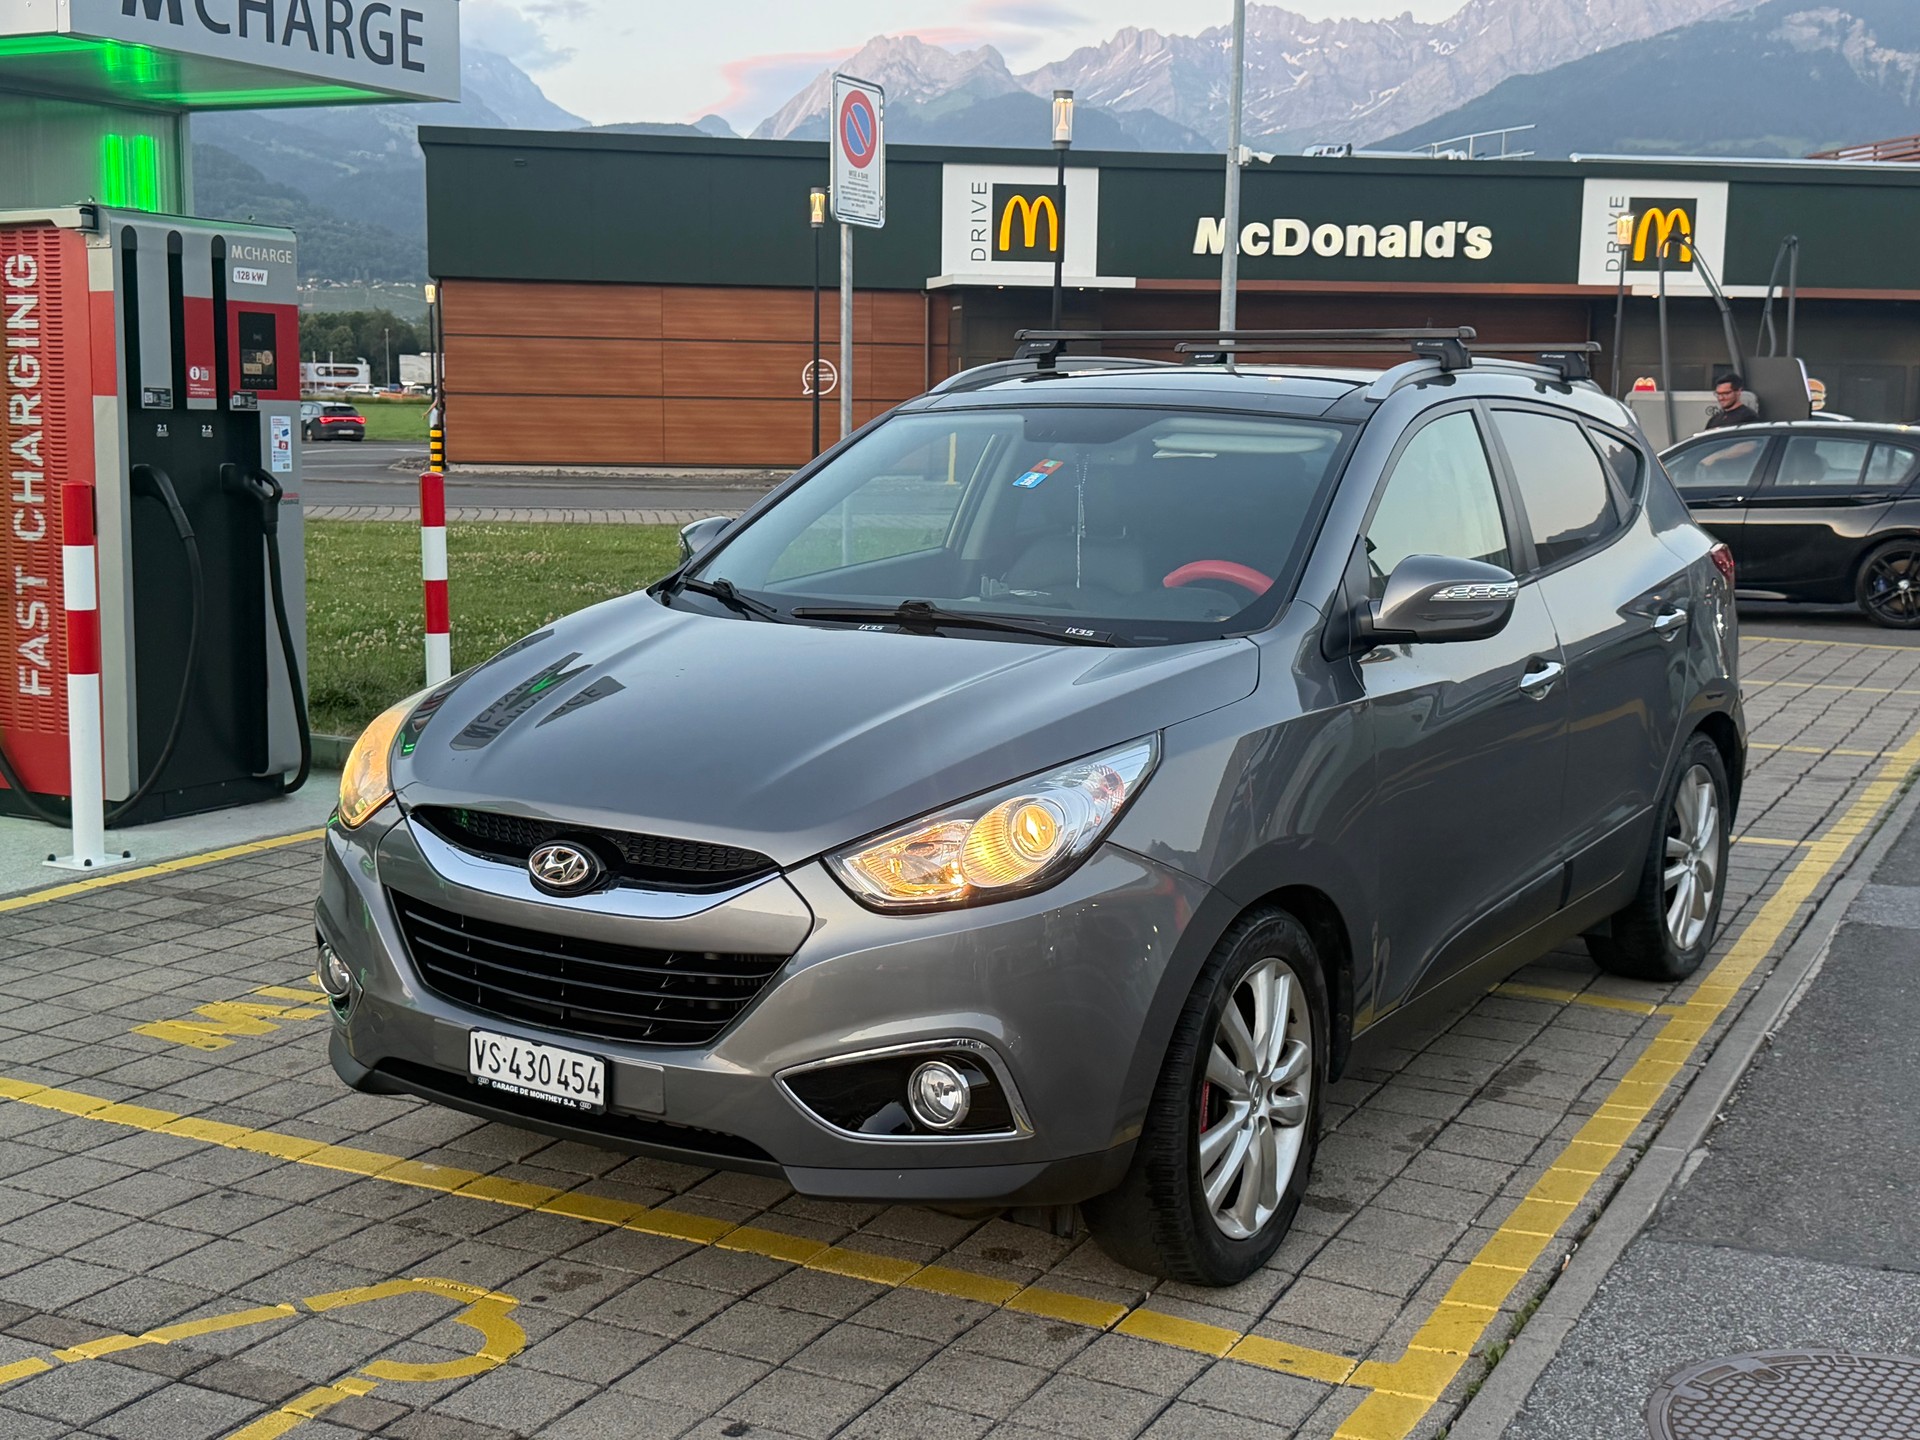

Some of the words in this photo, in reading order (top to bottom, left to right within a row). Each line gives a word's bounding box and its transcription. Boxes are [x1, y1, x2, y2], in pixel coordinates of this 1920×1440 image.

[970, 180, 988, 262] DRIVE
[1193, 217, 1493, 260] McDonald's
[236, 270, 250, 281] 128
[4, 253, 47, 542] CHARGING
[16, 565, 52, 697] FAST
[491, 1080, 519, 1094] GARAGE
[519, 1087, 530, 1097] DE
[529, 1089, 562, 1105] MONTHEY
